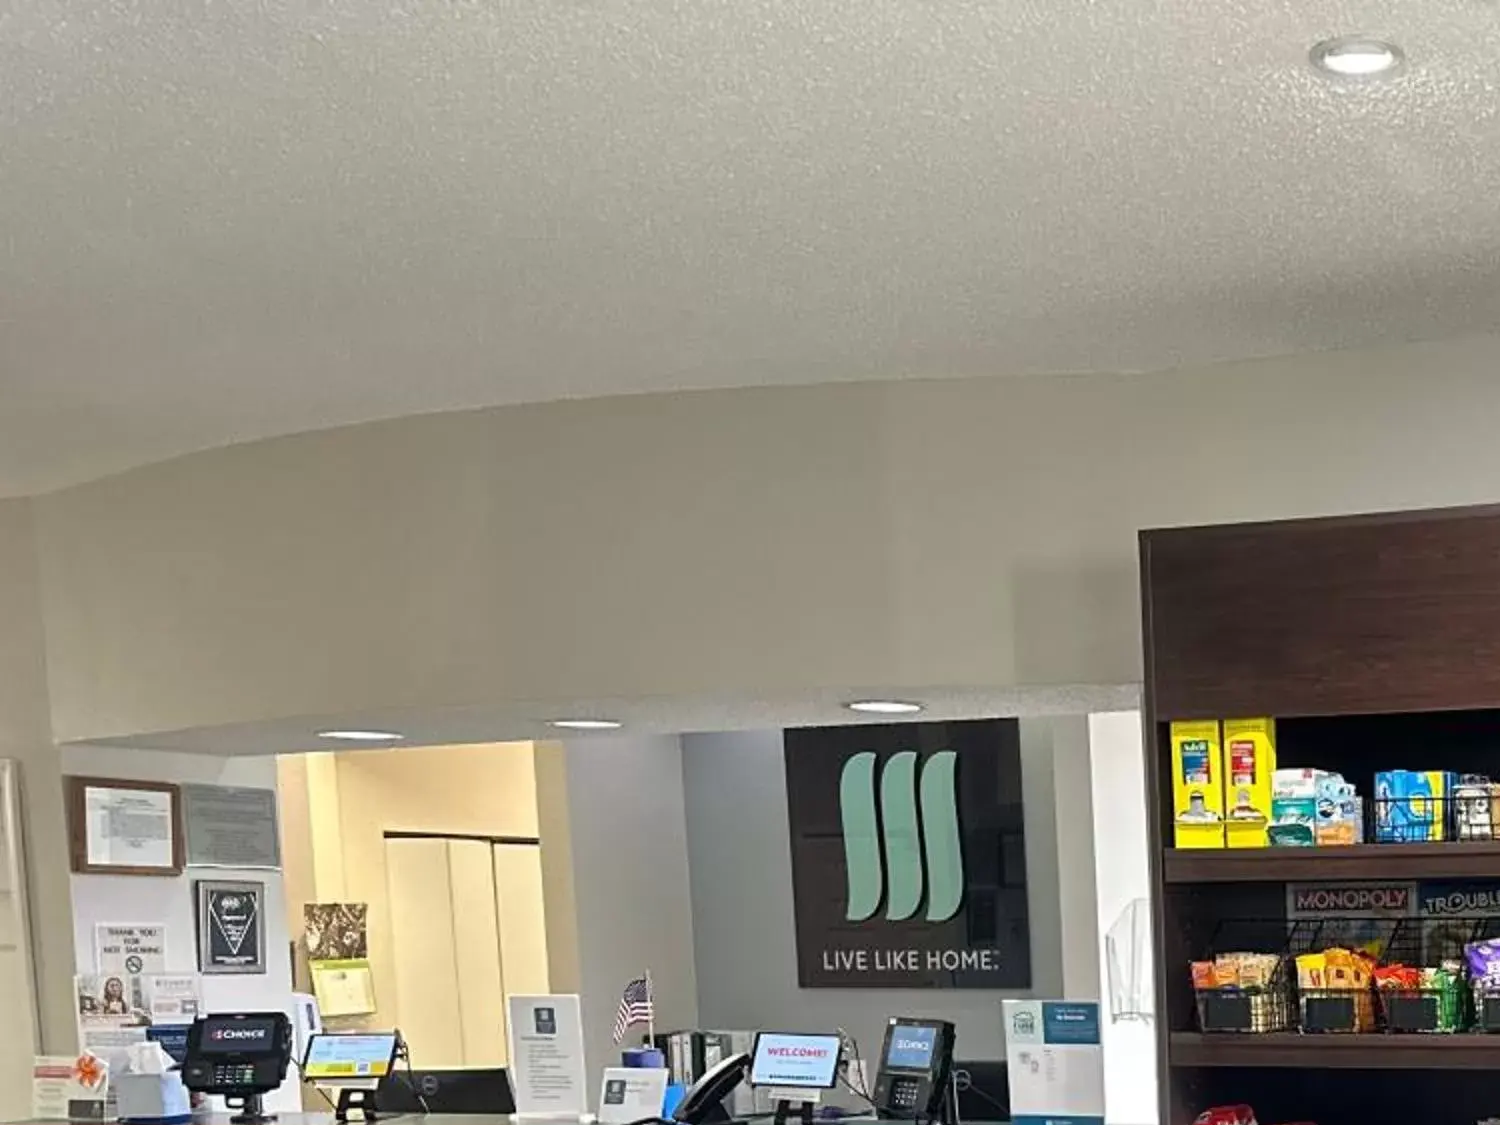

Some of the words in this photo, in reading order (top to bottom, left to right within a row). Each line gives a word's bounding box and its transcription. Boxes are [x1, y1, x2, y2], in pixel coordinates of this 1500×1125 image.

[1297, 888, 1406, 910] MONOPOLY
[823, 950, 867, 970] LIVE
[875, 950, 919, 970] LIKE
[223, 1029, 265, 1039] CHOICE
[768, 1047, 828, 1057] WELCOME!
